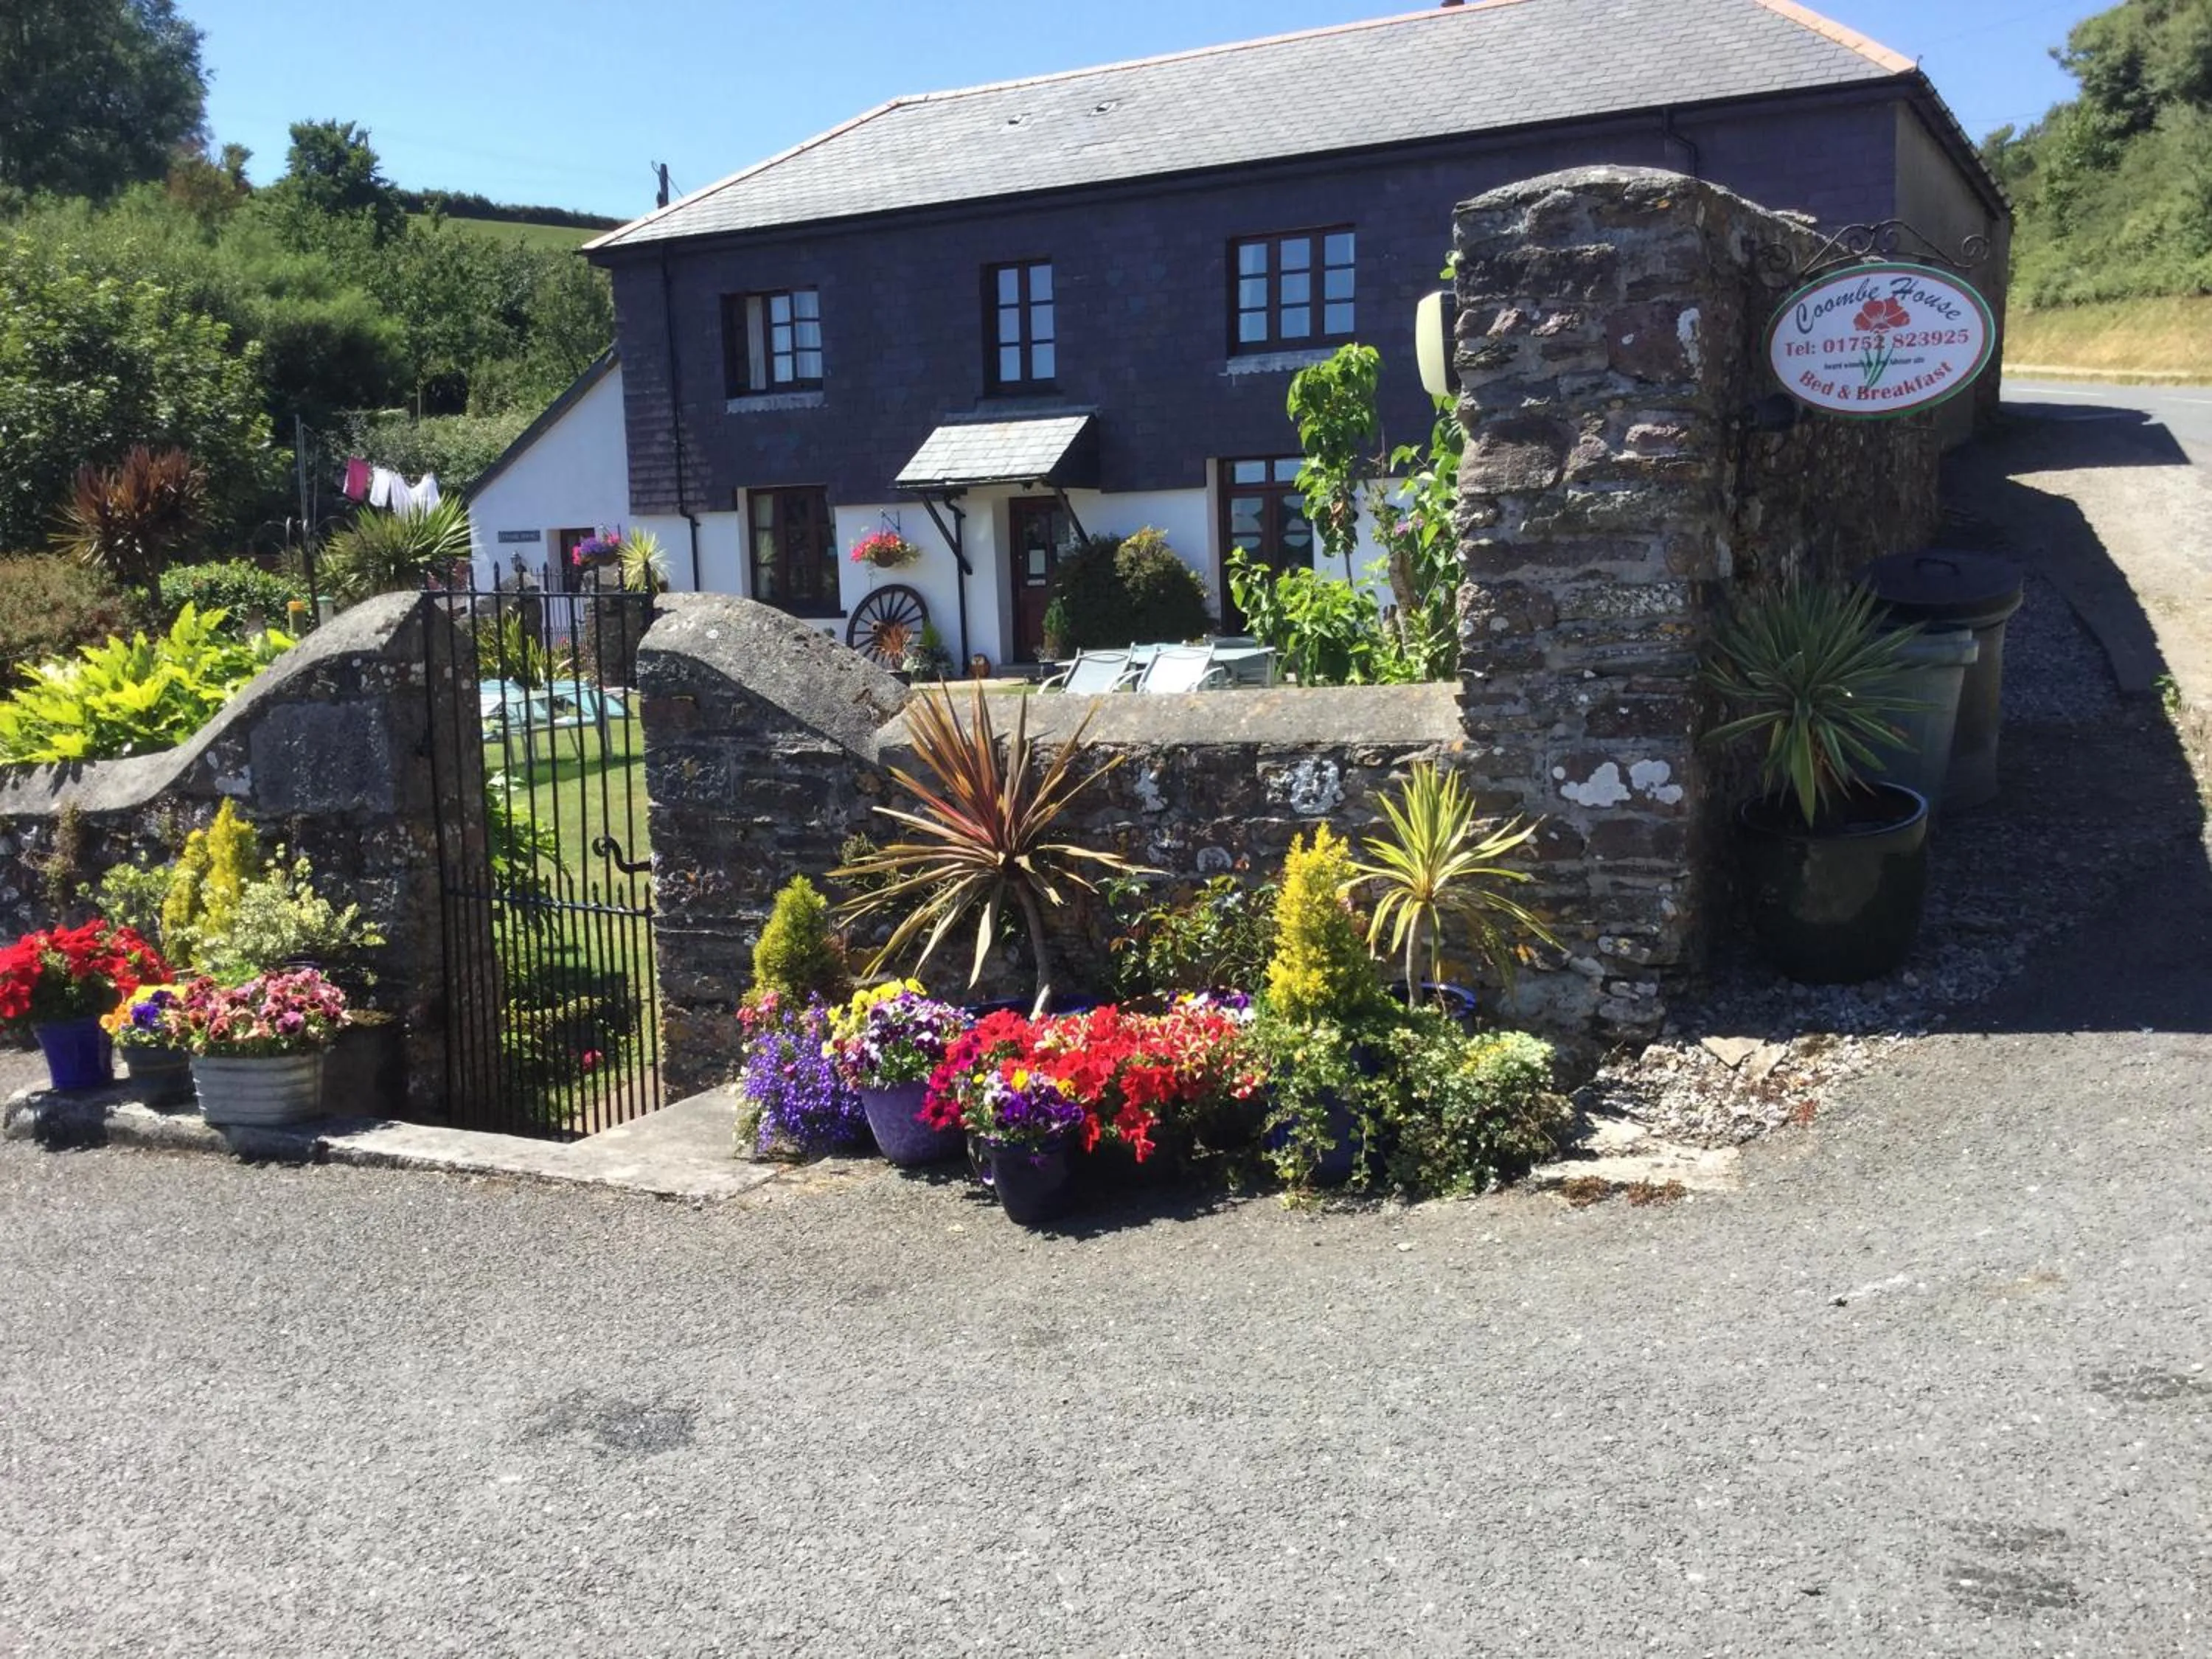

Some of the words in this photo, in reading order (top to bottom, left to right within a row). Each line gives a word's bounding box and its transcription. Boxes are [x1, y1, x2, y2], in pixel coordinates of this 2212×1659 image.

[1795, 277, 1880, 334] Coombe
[1889, 276, 1962, 321] House
[1786, 342, 1816, 357] Tel:
[1823, 336, 1885, 354] 01752
[1892, 329, 1969, 349] 823925
[1799, 369, 1834, 396] Bed
[1837, 385, 1851, 400] &
[1856, 361, 1954, 400] Breakfast
